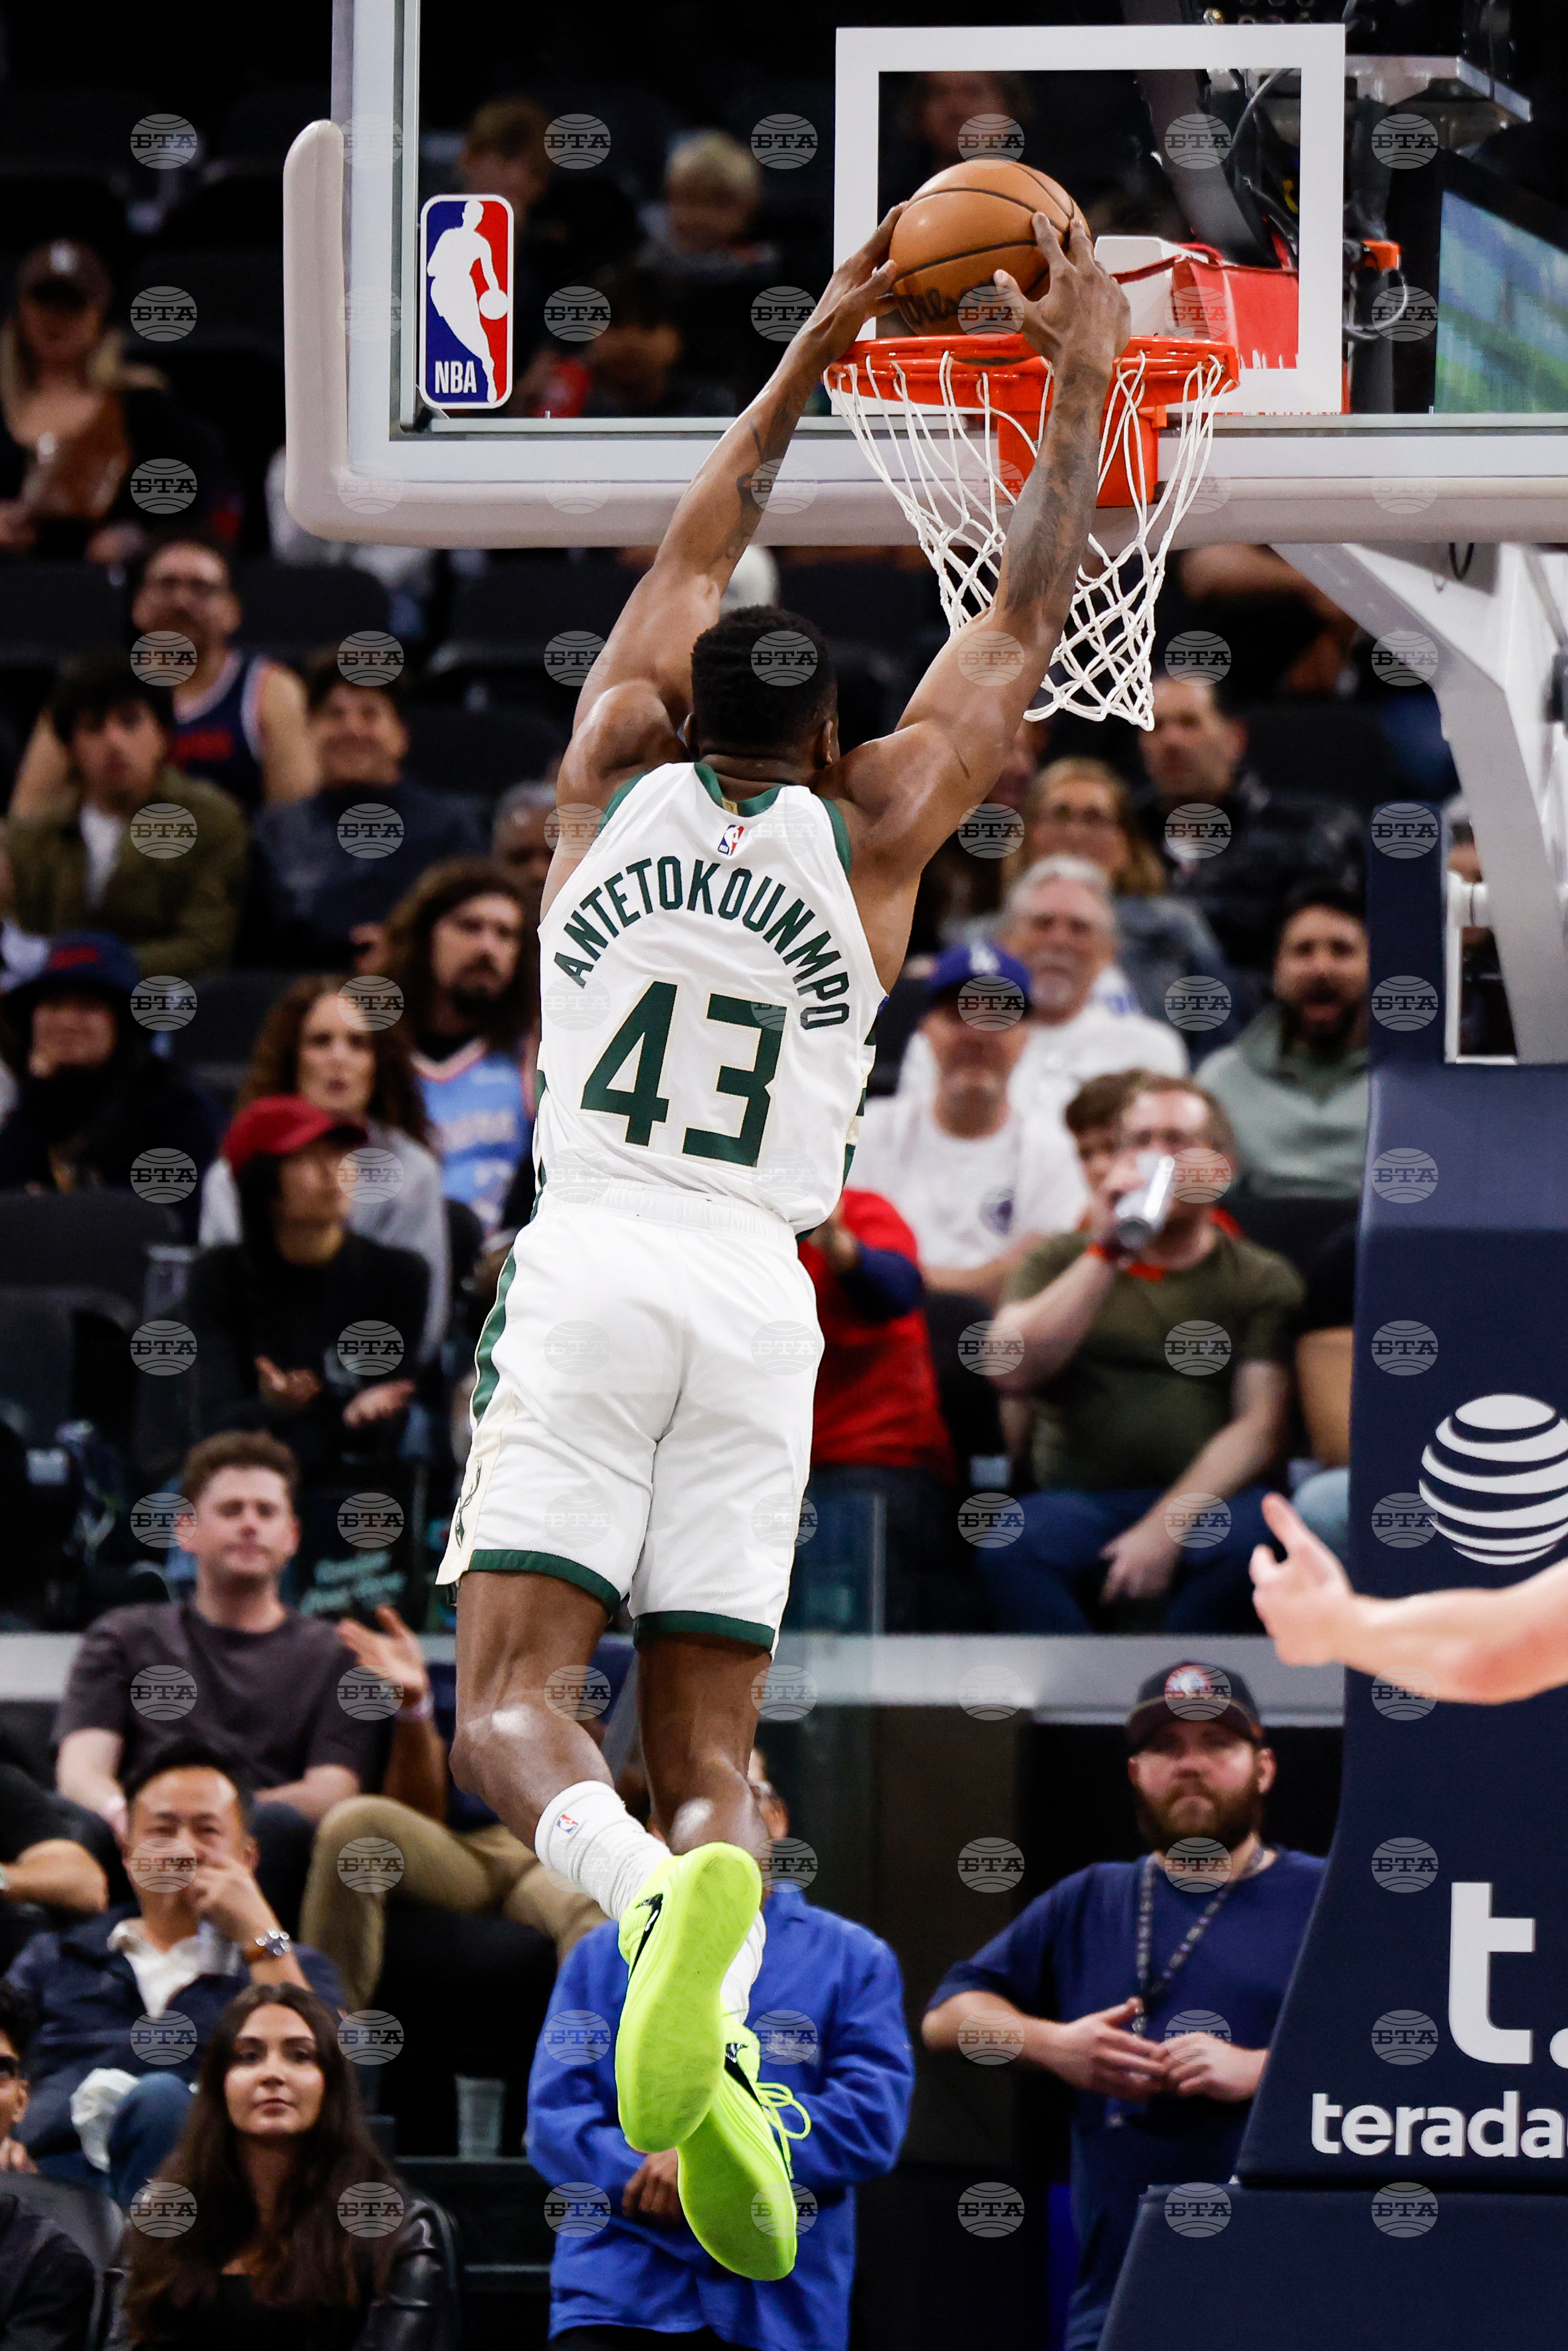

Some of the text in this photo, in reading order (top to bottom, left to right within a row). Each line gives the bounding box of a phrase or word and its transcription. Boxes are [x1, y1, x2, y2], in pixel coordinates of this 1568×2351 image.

[435, 361, 477, 394] NBA
[554, 856, 850, 1030] ANTETOKOUNMPO
[580, 981, 788, 1167] 43
[1312, 2091, 1568, 2159] terada
